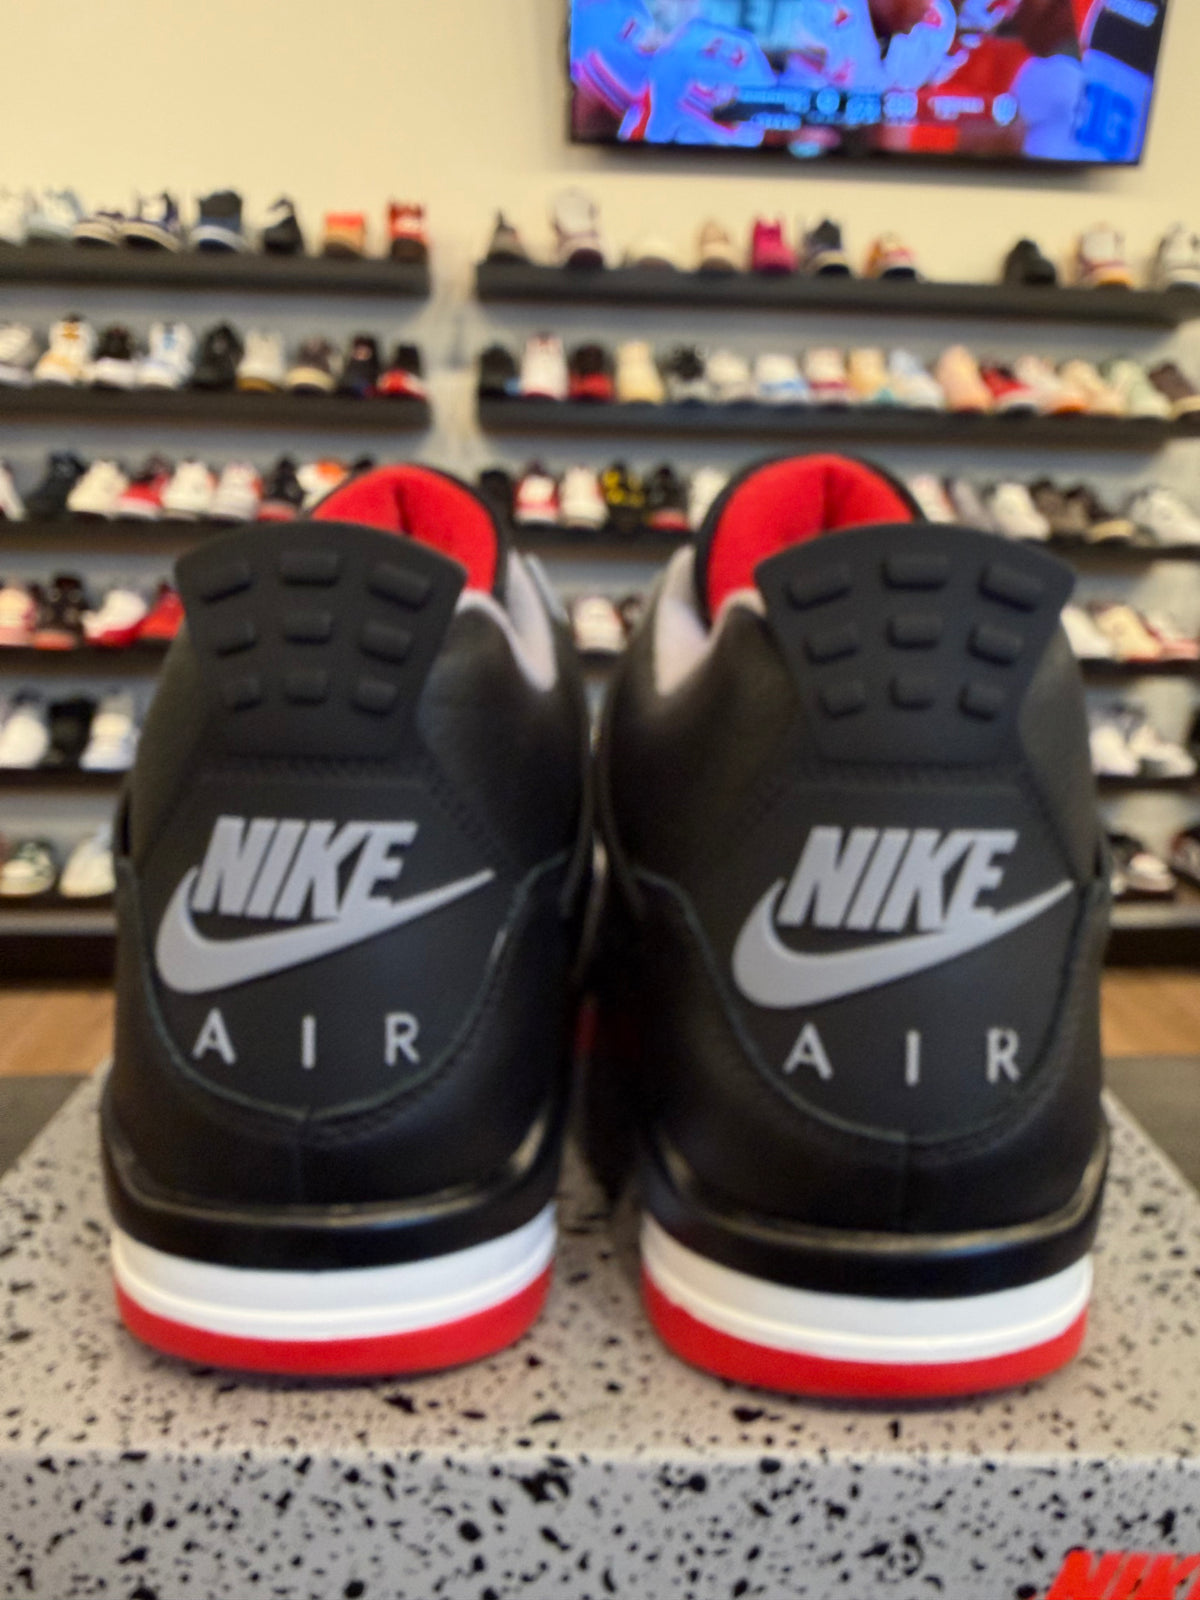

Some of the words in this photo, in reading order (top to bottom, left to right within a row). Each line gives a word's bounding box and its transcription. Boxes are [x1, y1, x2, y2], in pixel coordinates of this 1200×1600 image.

[192, 815, 419, 922] NIKE
[776, 825, 1018, 934] NIKE
[192, 1007, 420, 1070] AIR
[783, 1021, 1021, 1087] AIR
[1045, 1549, 1200, 1600] NIK
